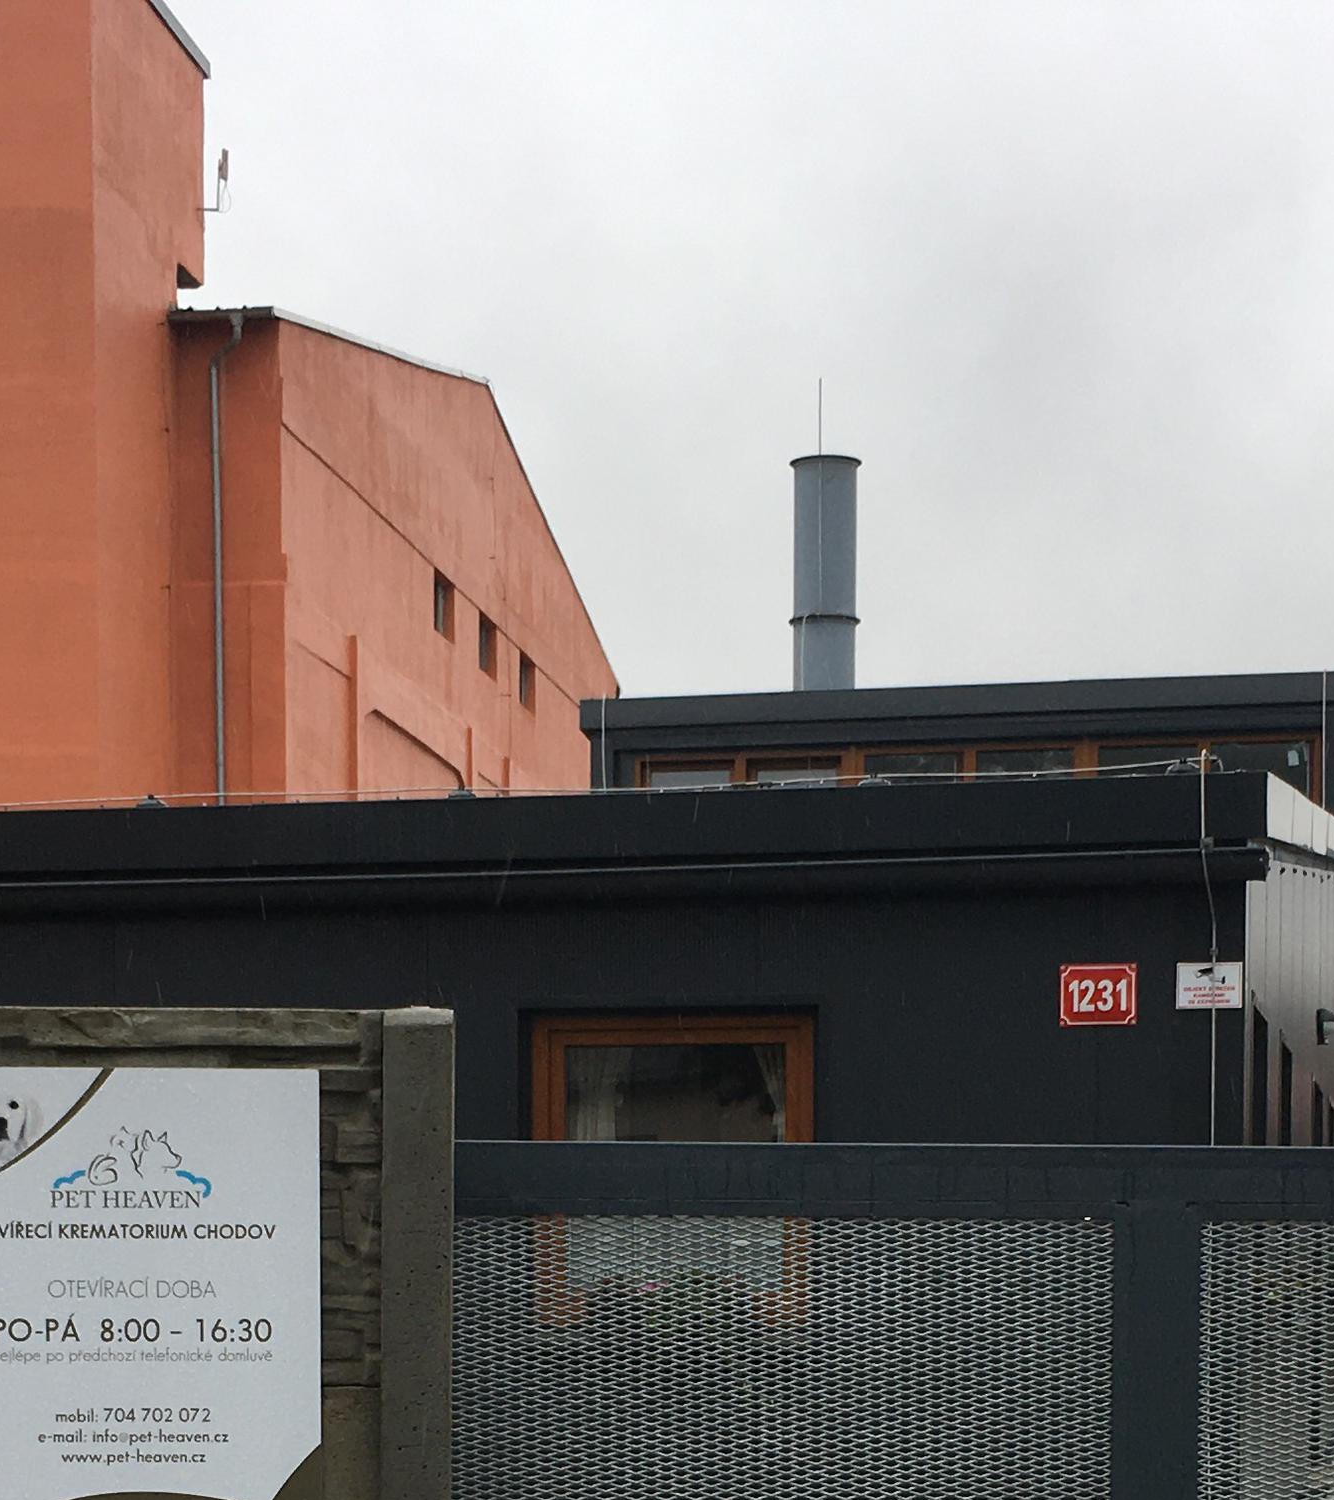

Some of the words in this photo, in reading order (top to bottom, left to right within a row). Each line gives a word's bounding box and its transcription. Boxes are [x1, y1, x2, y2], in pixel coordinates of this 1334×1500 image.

[1068, 979, 1129, 1012] 1231
[49, 1189, 96, 1209] PET
[101, 1189, 201, 1209] HEAVEN
[59, 1224, 187, 1239] KREMATORIUM
[194, 1224, 275, 1239] CHODOV
[48, 1276, 149, 1298] OTEVÍRACÍ
[156, 1280, 216, 1298] DOBA
[101, 1318, 160, 1342] 8:00
[196, 1319, 272, 1342] 16:30
[46, 1352, 65, 1364] po
[68, 1347, 136, 1363] předchozí
[140, 1347, 214, 1362] telefonické
[218, 1347, 273, 1362] domluvě
[56, 1408, 98, 1422] mobil:
[104, 1408, 135, 1422] 704
[141, 1408, 172, 1422] 702
[179, 1408, 211, 1422] 072
[38, 1429, 87, 1443] e-mail:
[61, 1448, 206, 1466] www.pet-heaven.cz
